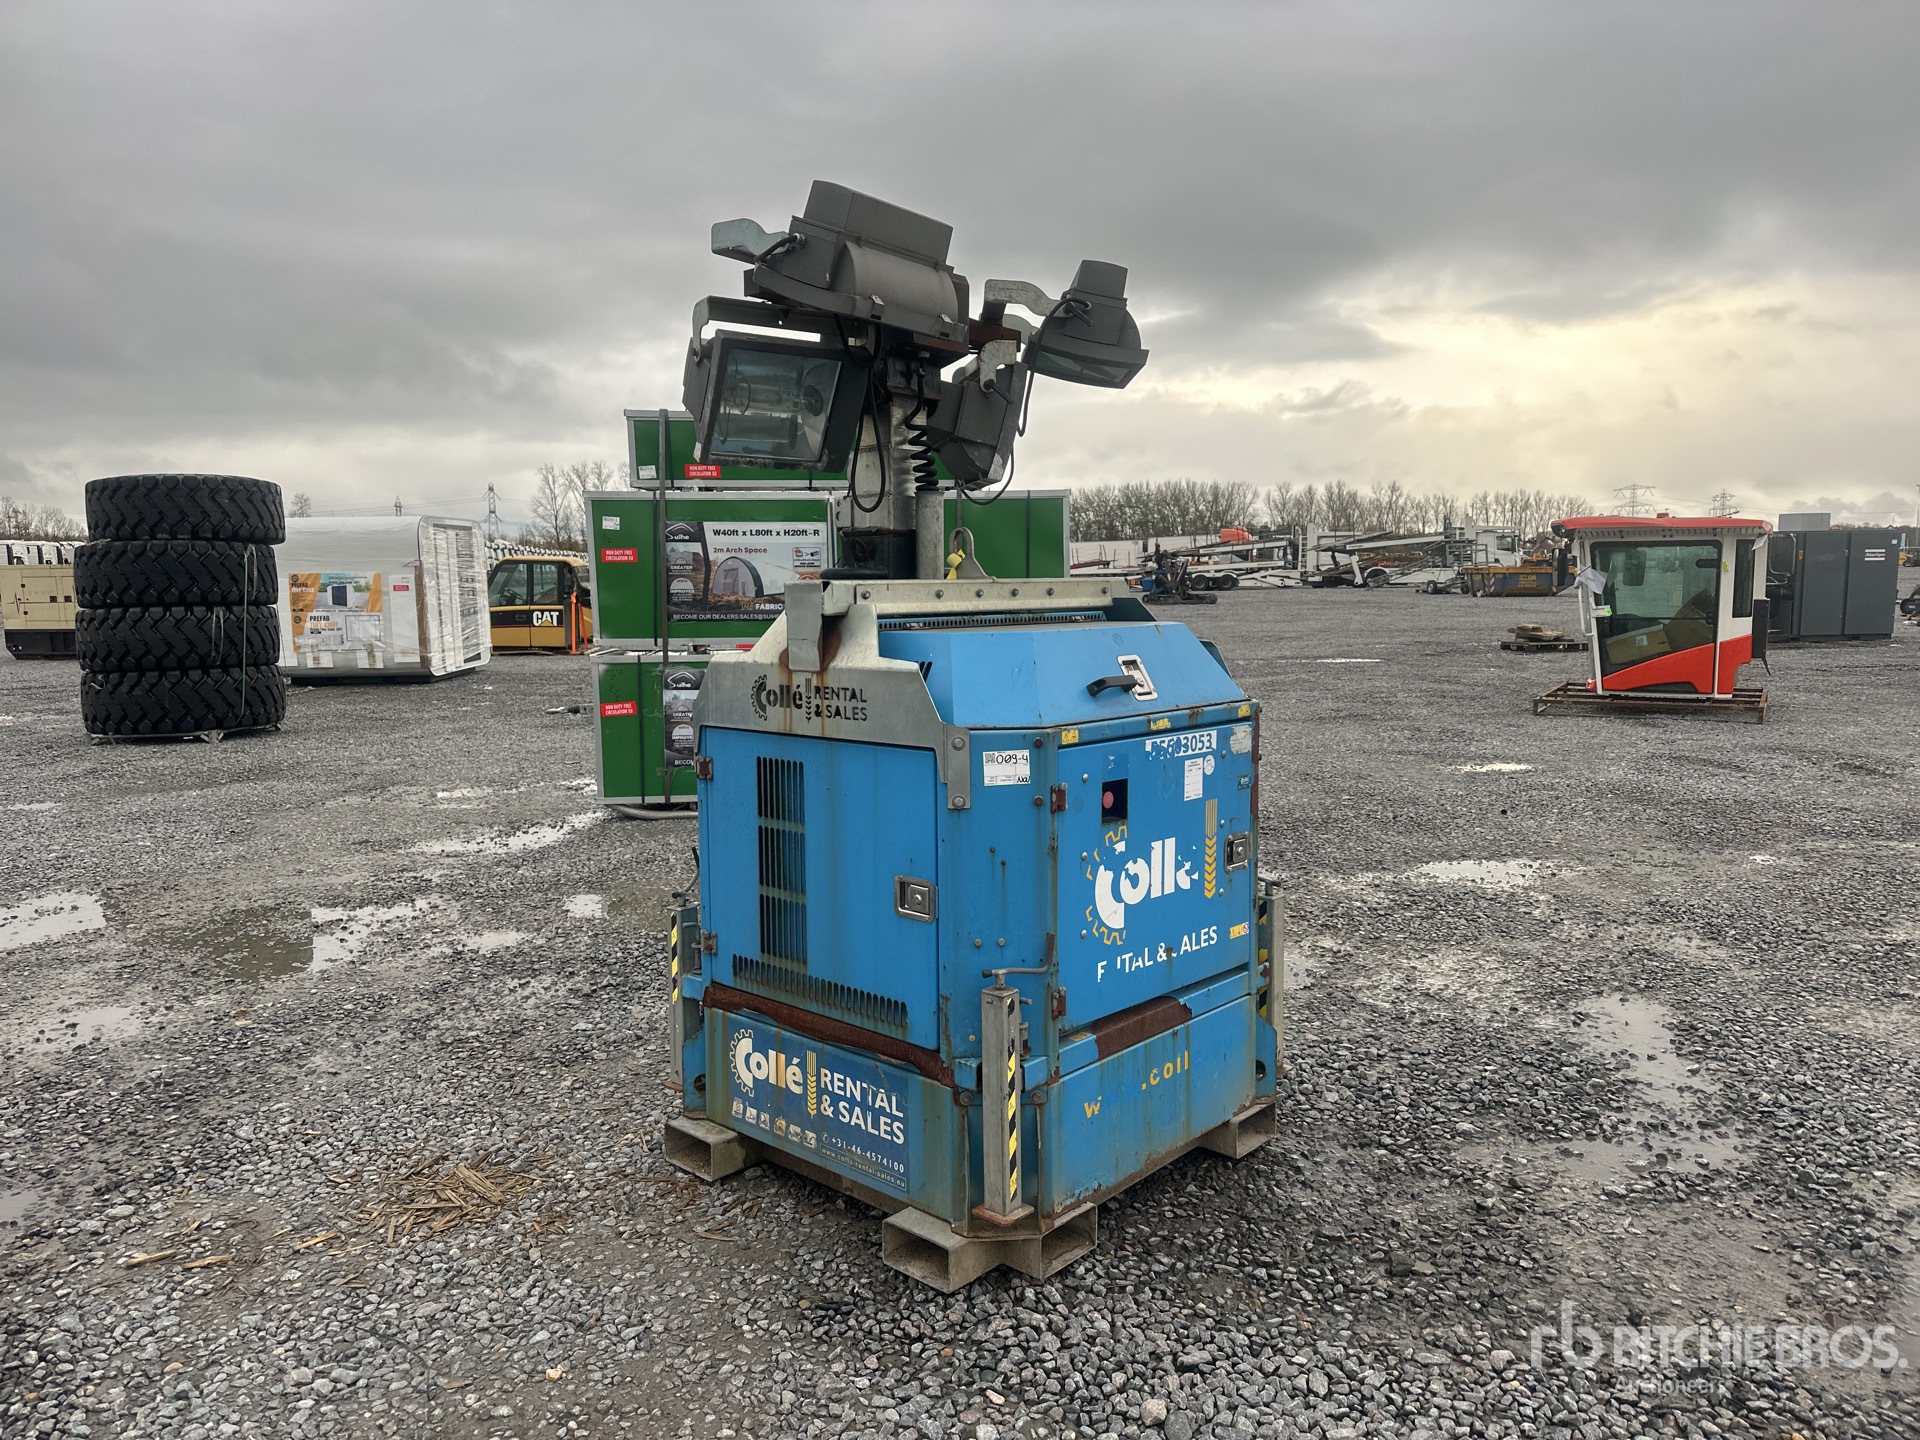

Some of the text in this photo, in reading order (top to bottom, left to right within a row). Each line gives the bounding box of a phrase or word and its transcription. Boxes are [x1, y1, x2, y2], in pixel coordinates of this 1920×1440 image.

[532, 611, 559, 627] CAT
[755, 681, 803, 714] Collé
[814, 686, 867, 703] RENTAL
[814, 704, 868, 721] & SALES
[1156, 942, 1168, 963] &
[735, 1037, 803, 1095] Collé
[820, 1067, 904, 1118] RENTAL
[820, 1094, 905, 1145] & SALES
[831, 1137, 904, 1173] +31-46-4574100
